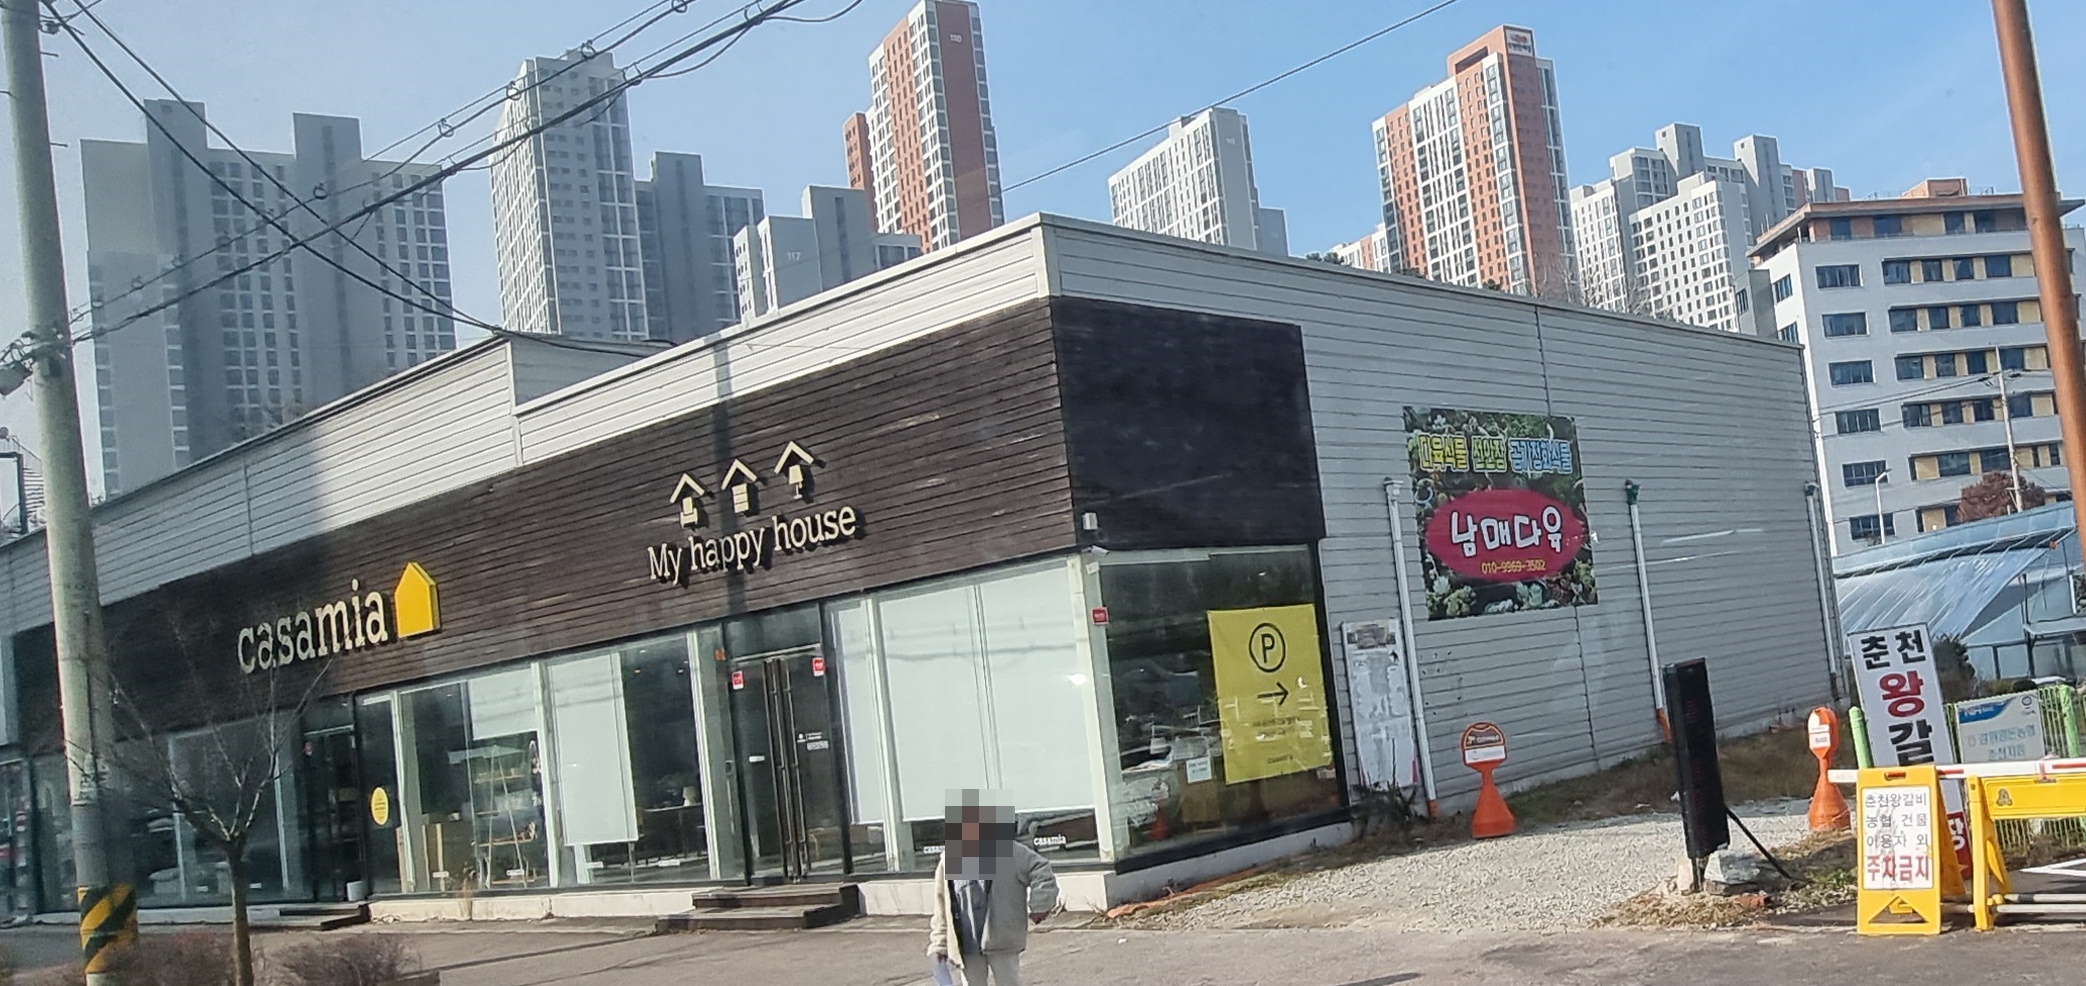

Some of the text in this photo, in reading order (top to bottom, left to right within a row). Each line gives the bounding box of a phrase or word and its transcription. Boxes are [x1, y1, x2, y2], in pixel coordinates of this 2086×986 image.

[1472, 436, 1507, 473] 선인장
[647, 506, 857, 586] My happy house
[1451, 506, 1562, 557] 남매다육
[238, 578, 389, 674] casamia
[1860, 629, 1927, 671] 춘천
[1865, 793, 1927, 808] 춘천왕갈비
[1033, 834, 1067, 846] casamia
[1866, 833, 1929, 849] 이용자 외
[1867, 855, 1929, 882] 주차금지
